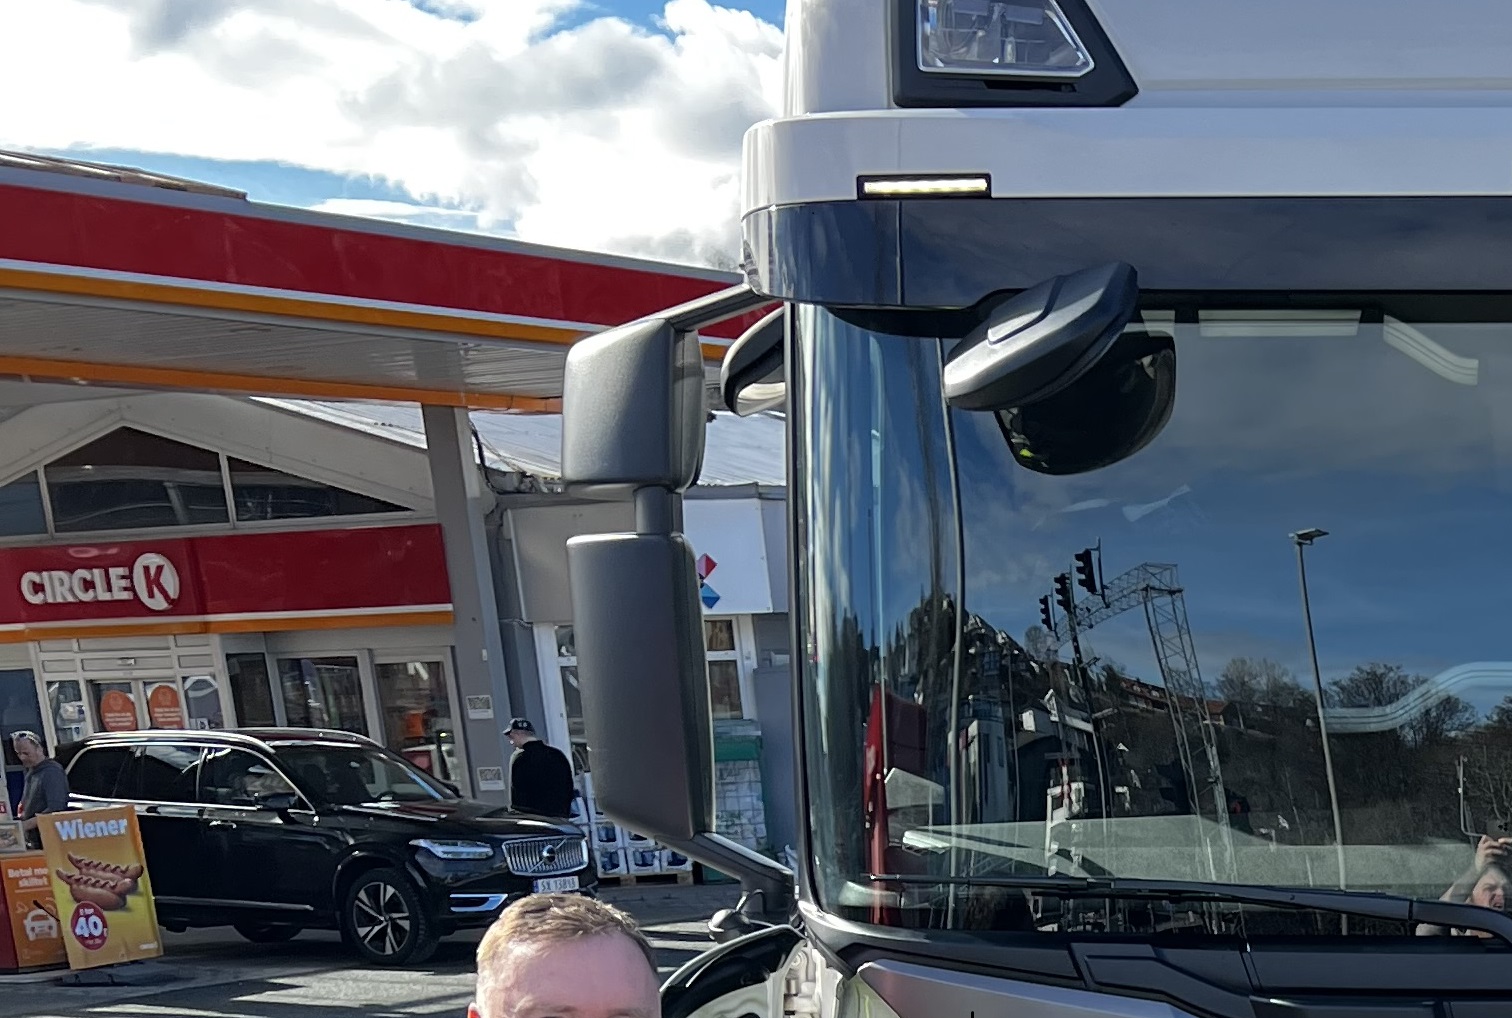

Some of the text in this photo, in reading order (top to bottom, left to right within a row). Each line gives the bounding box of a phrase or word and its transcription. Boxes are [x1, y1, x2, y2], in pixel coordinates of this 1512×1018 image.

[20, 561, 178, 608] CIRCLE K
[54, 818, 128, 842] Wiener
